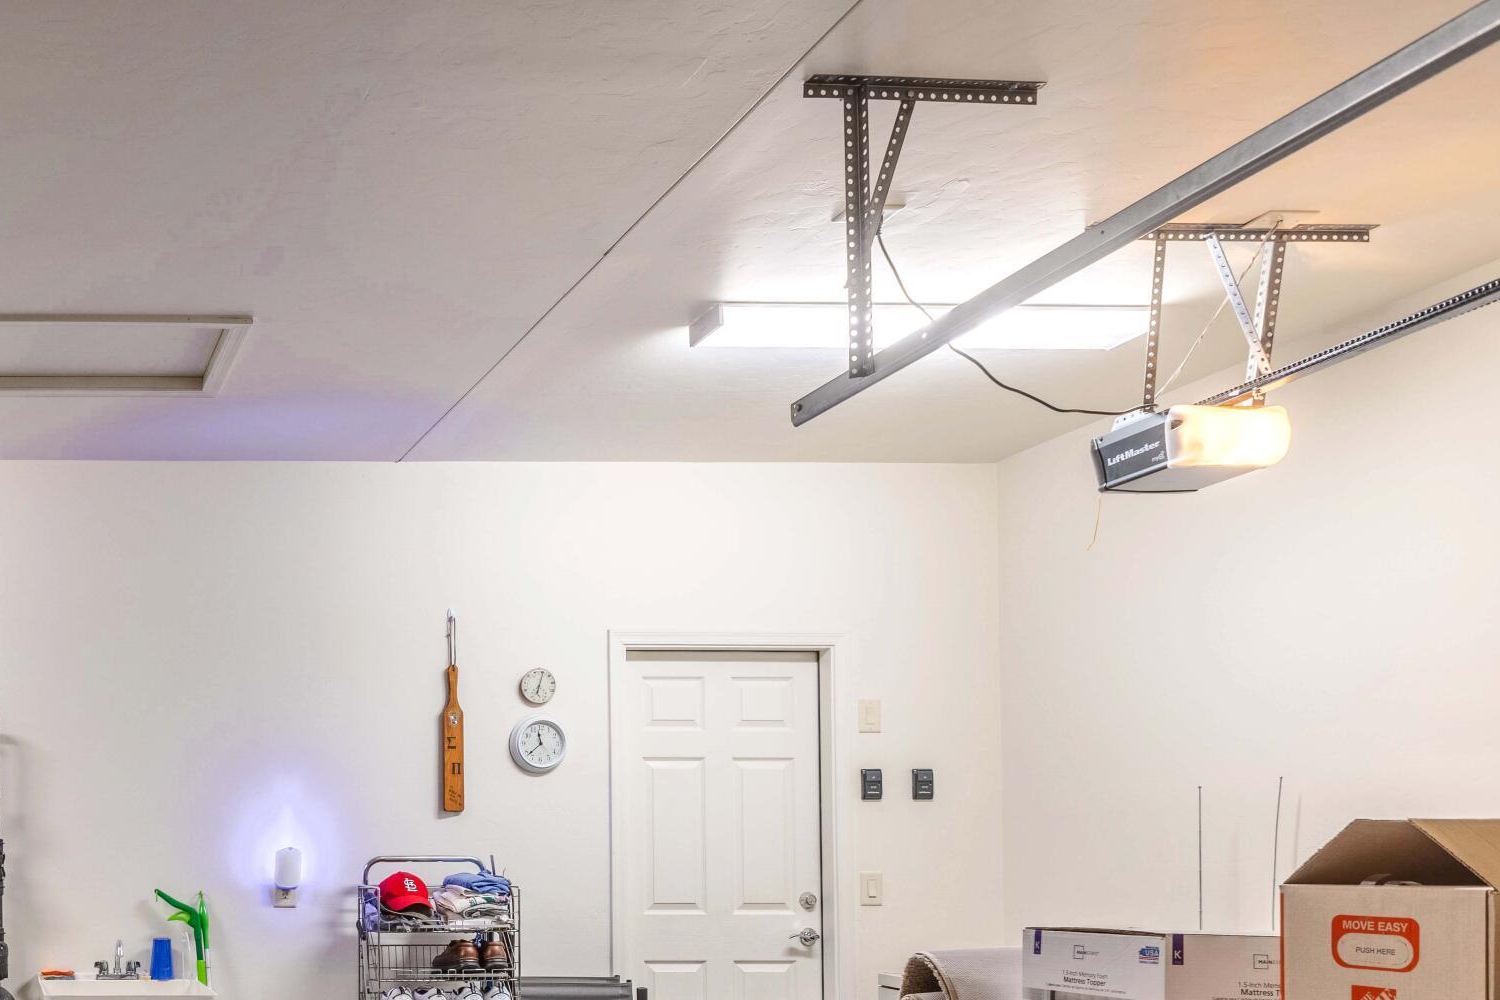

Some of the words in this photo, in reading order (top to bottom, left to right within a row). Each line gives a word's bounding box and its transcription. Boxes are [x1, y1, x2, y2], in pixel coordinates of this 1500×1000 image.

[1108, 441, 1160, 467] LiftMaster
[1342, 919, 1375, 931] MOVE
[1378, 921, 1409, 933] EASY
[1145, 949, 1159, 957] USA
[1174, 950, 1182, 959] K
[1355, 946, 1374, 954] PUSH
[1377, 948, 1396, 956] HERE
[1063, 976, 1085, 985] Mattress
[1087, 978, 1106, 987] Topper
[1240, 989, 1274, 997] Mattress
